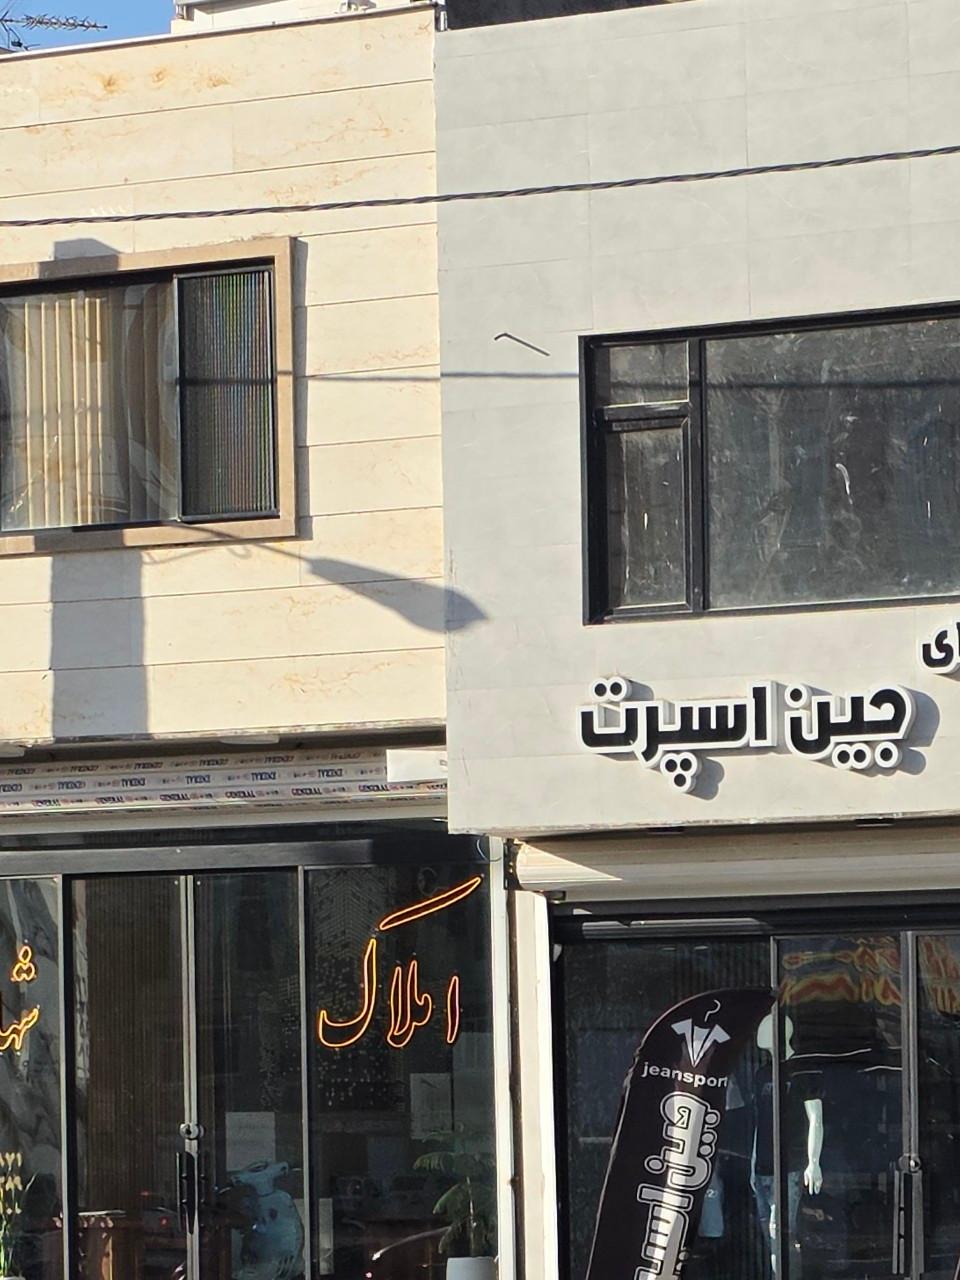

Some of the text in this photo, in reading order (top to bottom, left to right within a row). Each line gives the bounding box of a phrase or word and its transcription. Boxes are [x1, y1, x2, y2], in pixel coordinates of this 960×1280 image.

[577, 676, 914, 793] جین اسپرت
[318, 875, 484, 1048] املاک
[641, 1061, 729, 1088] jeansport
[644, 1091, 721, 1190] جین
